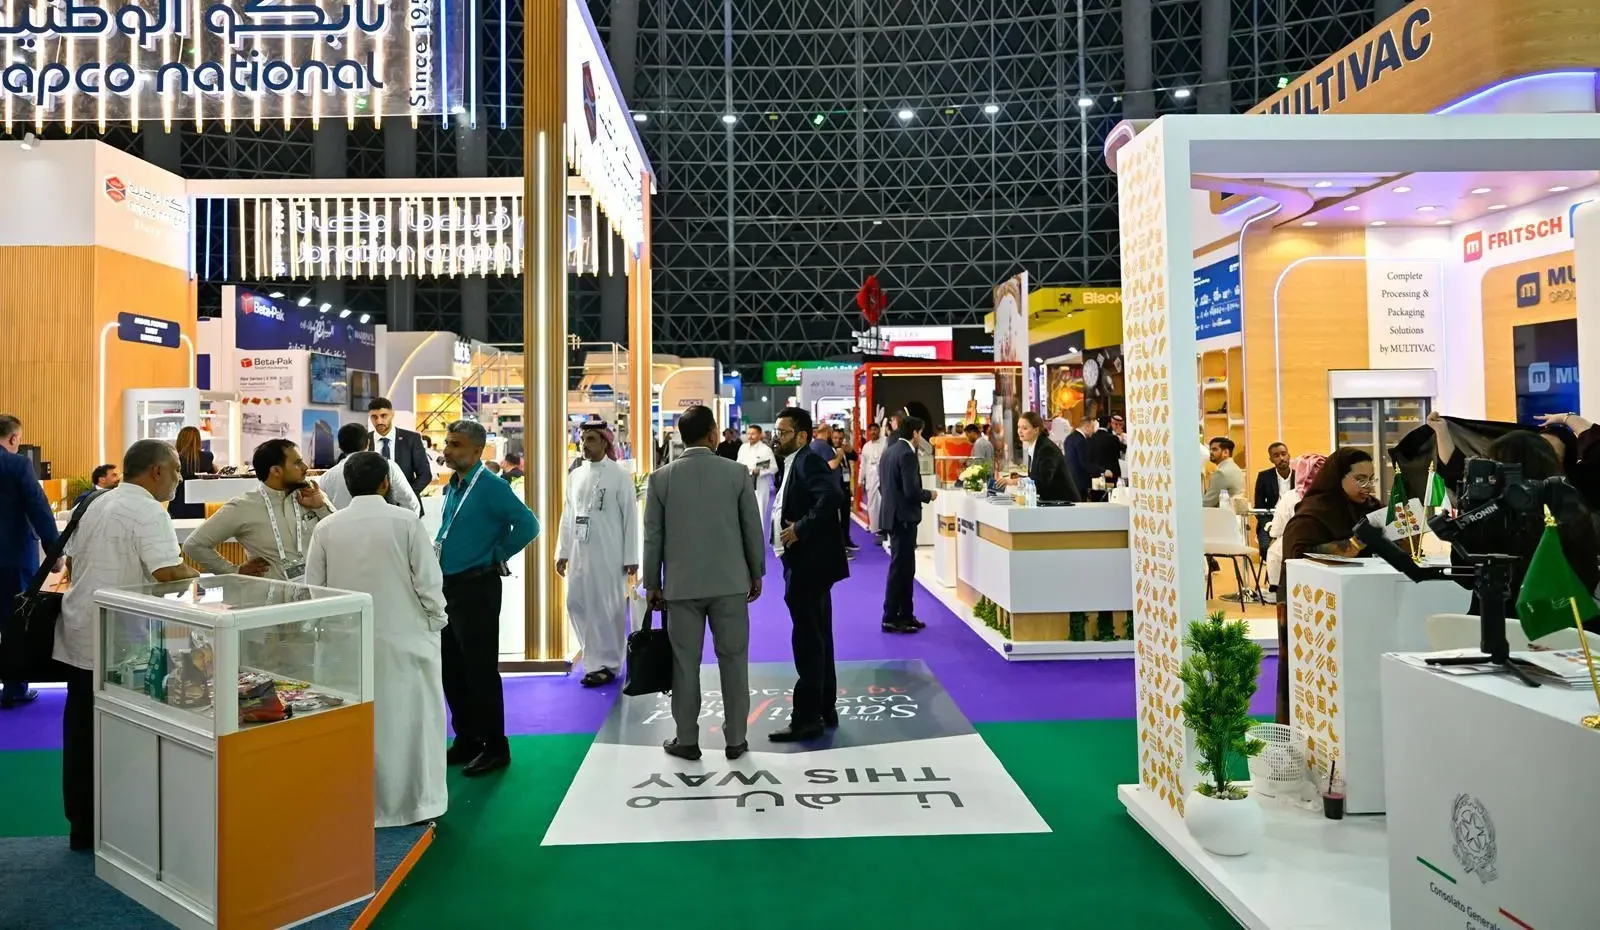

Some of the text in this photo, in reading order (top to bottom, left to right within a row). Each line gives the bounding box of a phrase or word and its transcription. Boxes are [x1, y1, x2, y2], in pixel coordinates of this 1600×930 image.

[157, 50, 384, 92] national
[409, 42, 428, 107] Since
[1488, 216, 1563, 249] FRITSCH
[1387, 272, 1423, 283] Complete
[1381, 289, 1430, 300] Processing &
[254, 300, 285, 322] Beta-Pak
[1387, 308, 1425, 319] Packaging
[1389, 325, 1425, 335] Solutions
[1380, 343, 1436, 355] by MULTIVAC
[254, 357, 293, 366] Beta-Pak
[1469, 504, 1499, 522] RONIN
[631, 766, 952, 789] THIS WAY
[1429, 881, 1500, 930] Consolato General
